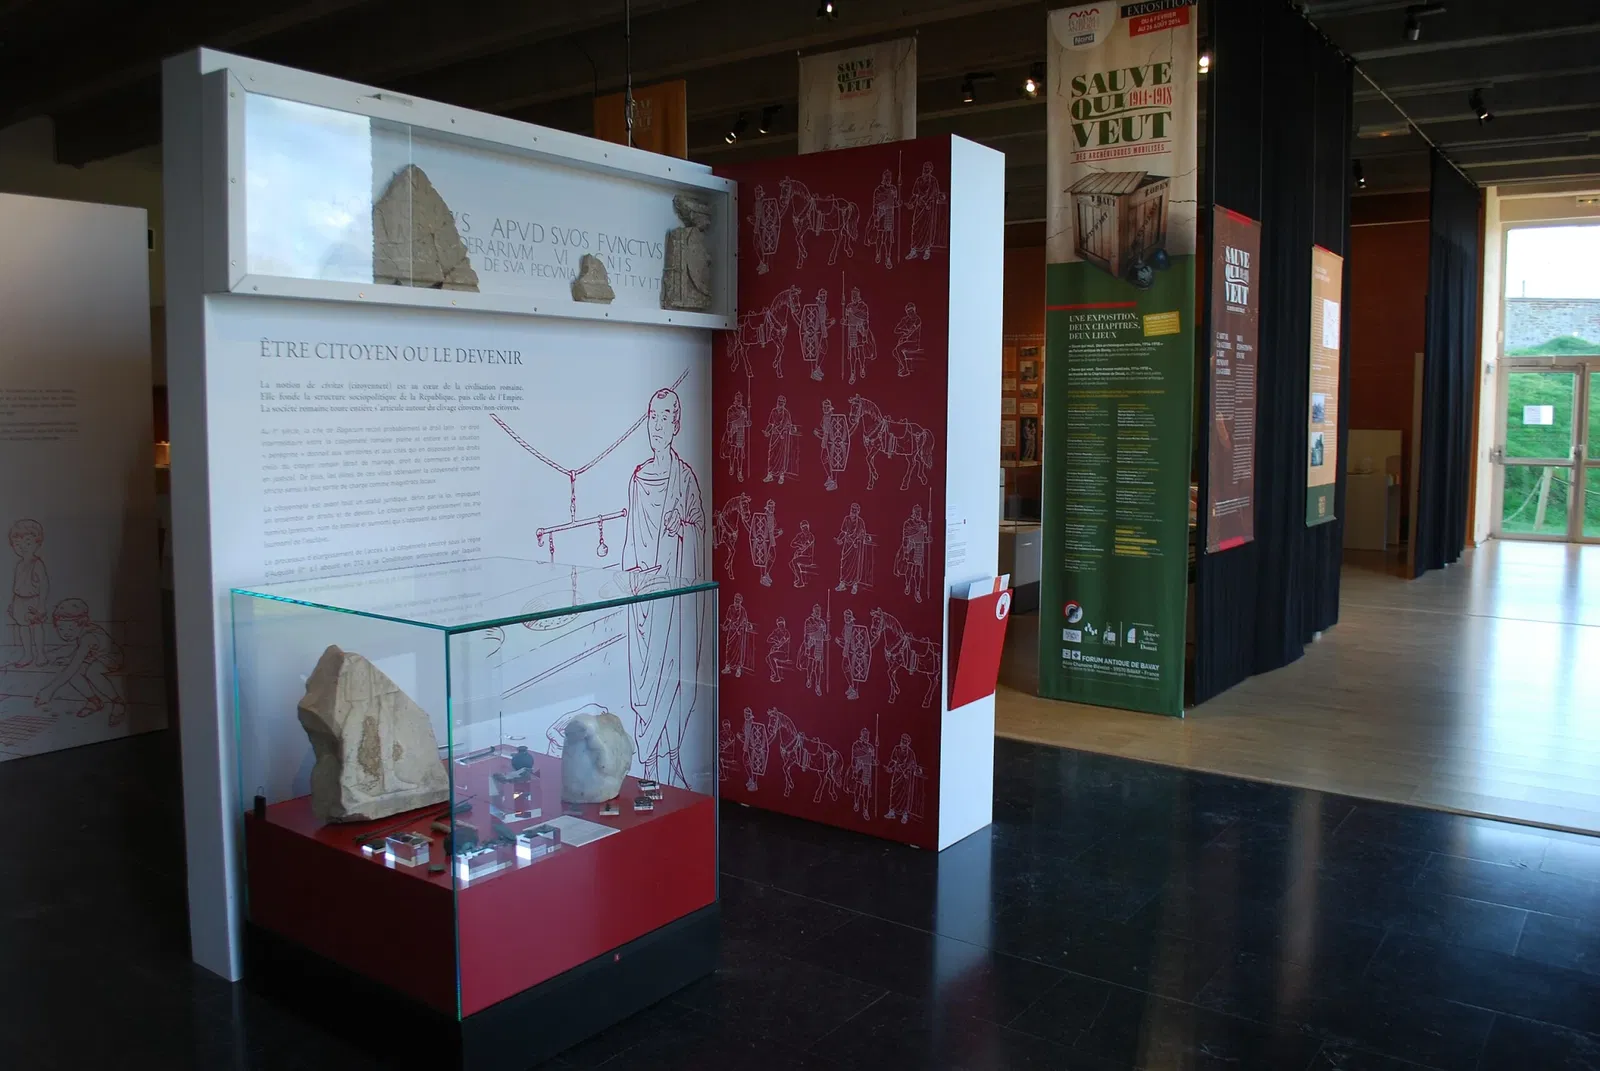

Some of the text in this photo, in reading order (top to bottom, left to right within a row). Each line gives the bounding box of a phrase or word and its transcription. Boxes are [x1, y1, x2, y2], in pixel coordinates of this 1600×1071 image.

[1075, 35, 1093, 45] Nord
[837, 58, 874, 74] SAUVE
[837, 71, 857, 82] QUI
[1071, 62, 1172, 99] SAUVE
[837, 77, 875, 93] VEUT
[1071, 86, 1172, 121] QUI 1914-1918
[1071, 112, 1172, 148] VEUT
[1076, 144, 1165, 161] DES ARCHÉOLOGUES MOBILISÉS
[491, 217, 545, 243] APVD
[551, 226, 589, 249] SVOS
[597, 232, 663, 260] FVNCTVS
[553, 248, 568, 265] VI
[1225, 246, 1250, 269] SAUVE
[484, 257, 500, 273] DE
[503, 259, 526, 275] SVA
[531, 263, 577, 282] PECVNIA
[1225, 281, 1249, 305] VEUT
[1069, 314, 1085, 323] UNE
[1069, 324, 1090, 332] DEUX
[1069, 331, 1117, 340] DEUX LIEUX
[259, 337, 524, 366] ÊTRE CITOYEN OU LE DEVENIR
[260, 380, 270, 389] La
[276, 380, 301, 389] notion
[306, 380, 316, 389] de
[321, 381, 345, 389] civitas
[443, 382, 451, 390] de
[455, 382, 461, 390] la
[465, 383, 497, 391] civilisation
[279, 392, 300, 401] fonde
[304, 392, 311, 400] la
[314, 393, 346, 401] structure
[400, 393, 407, 401] de
[260, 404, 271, 413] La
[437, 404, 457, 413] clivage
[1082, 655, 1103, 665] FORUM
[1104, 658, 1130, 668] ANTIQUE
[1131, 661, 1139, 669] DE
[1140, 662, 1160, 671] BAVAY
